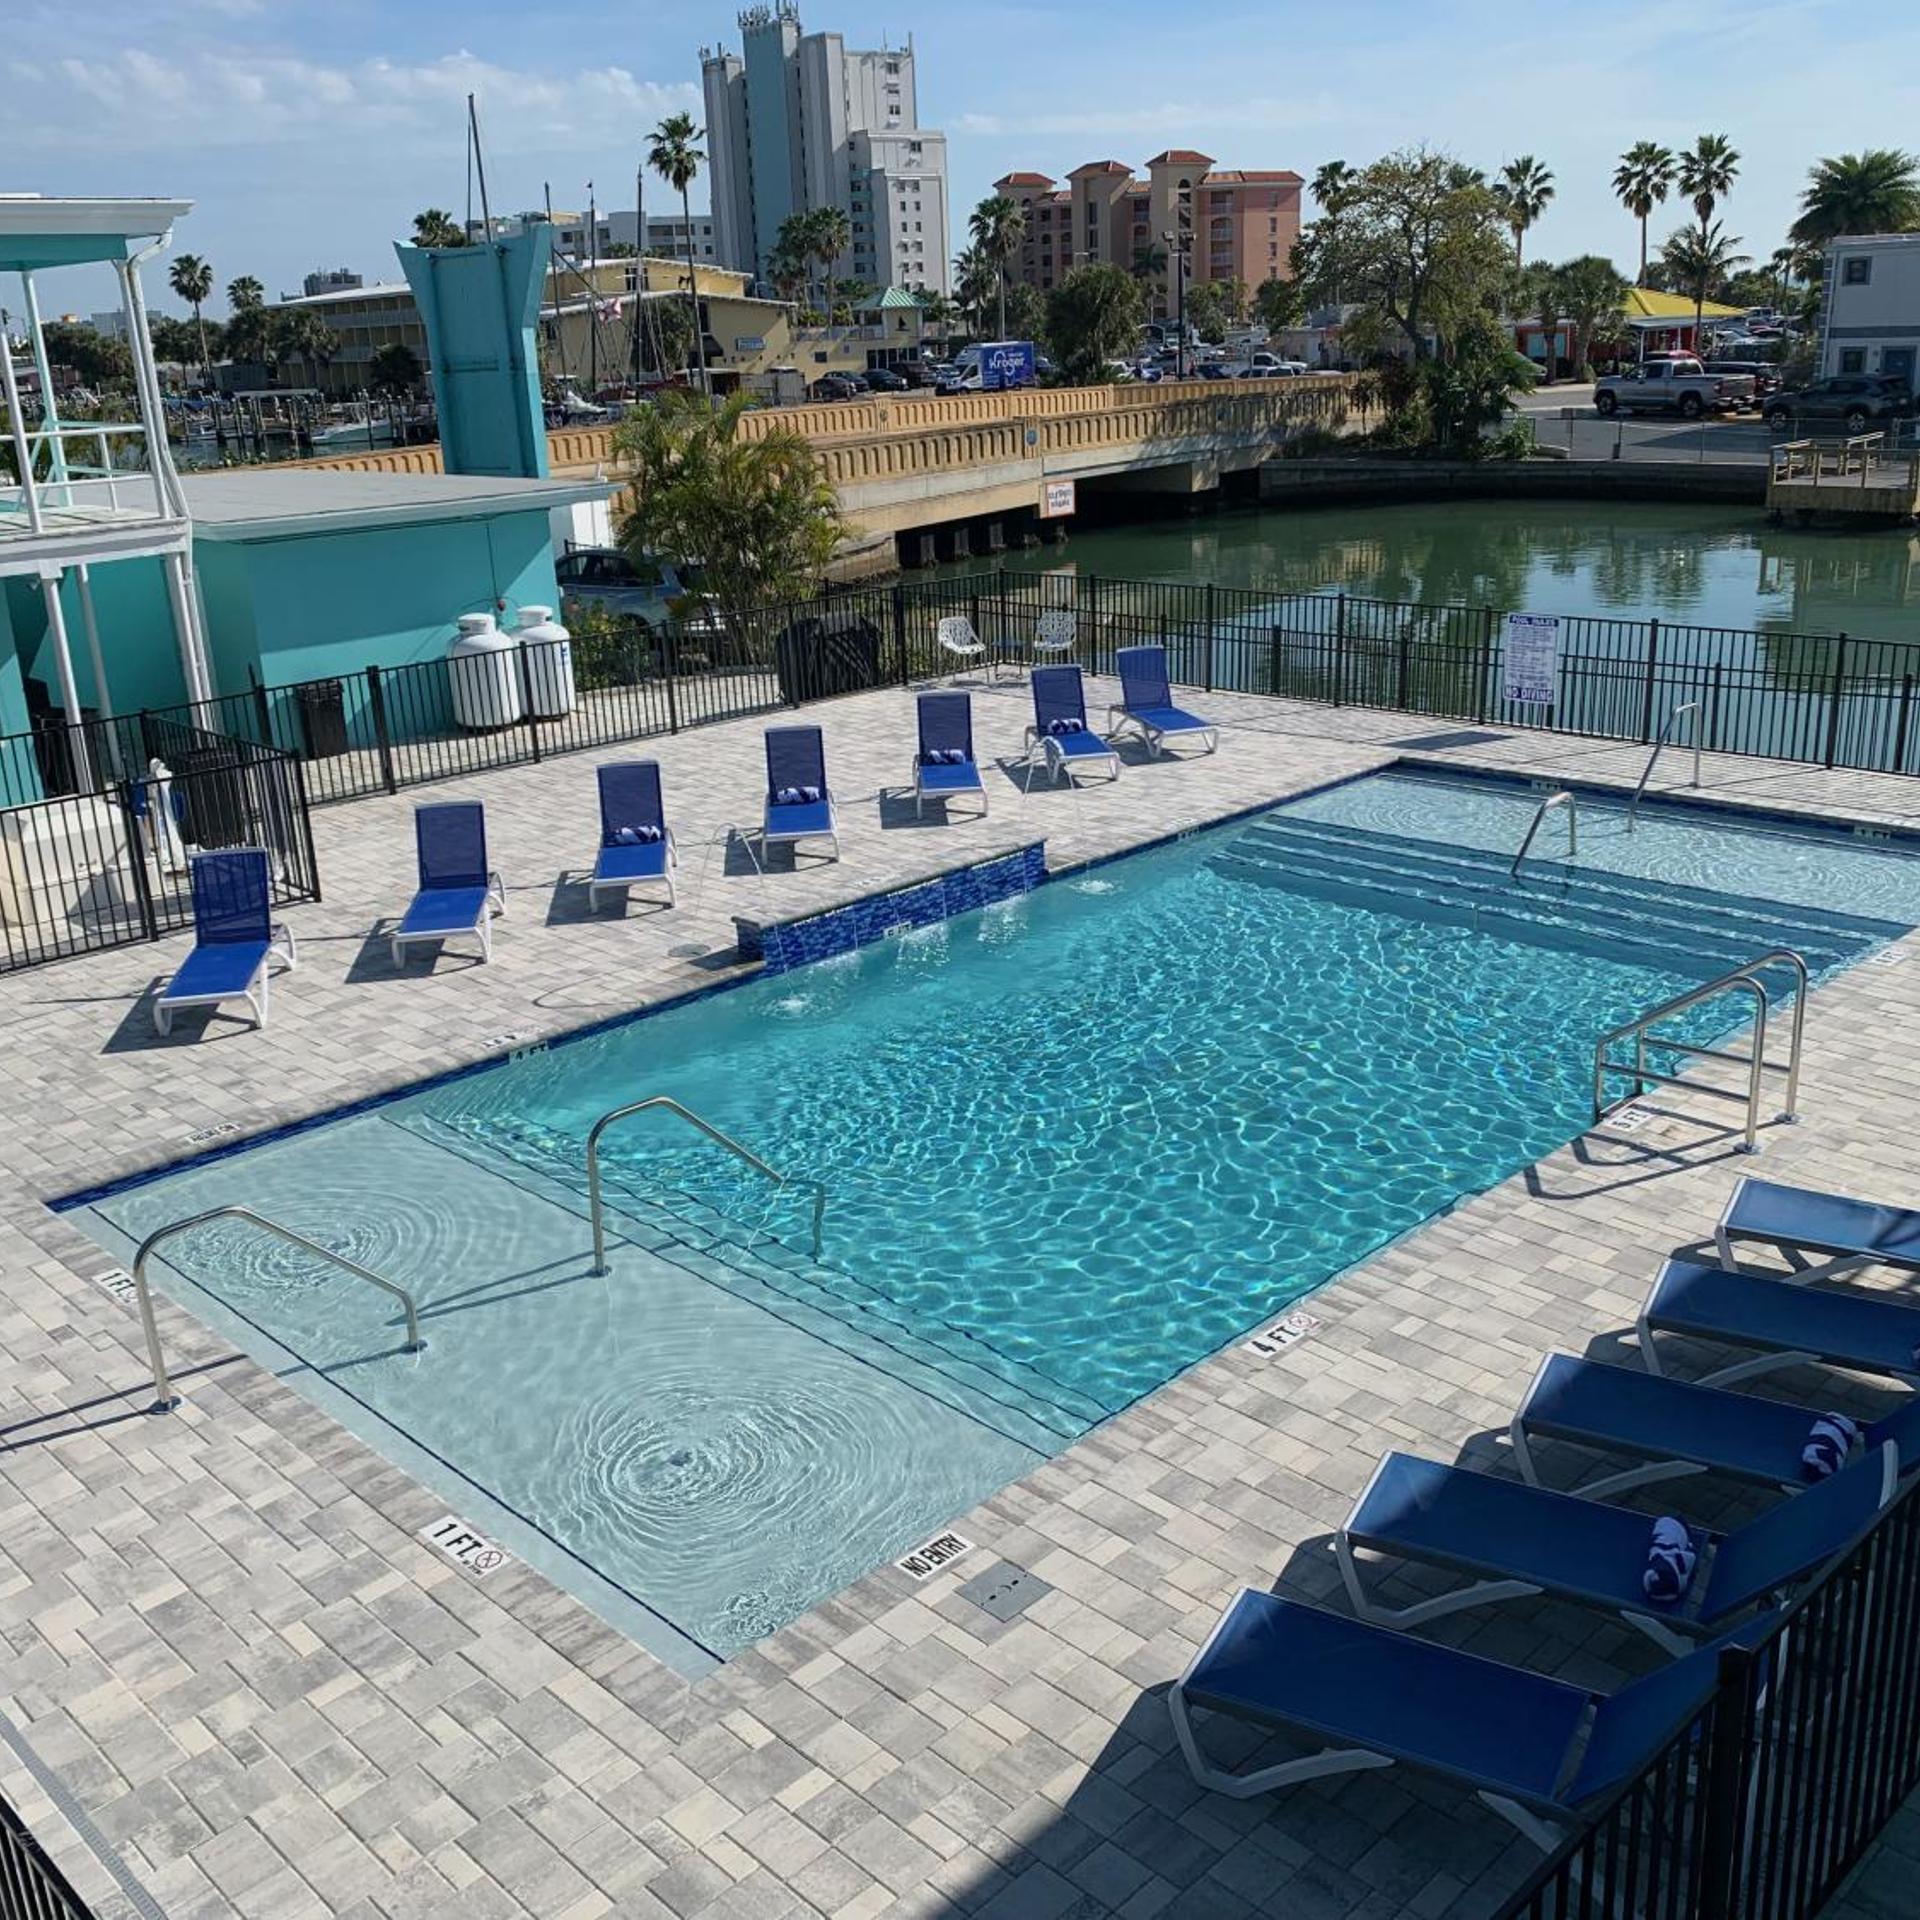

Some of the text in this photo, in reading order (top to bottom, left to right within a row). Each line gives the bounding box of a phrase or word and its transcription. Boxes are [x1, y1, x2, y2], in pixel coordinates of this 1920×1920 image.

[1505, 686, 1553, 701] NO DIVING
[1251, 1325, 1299, 1353] 4 FT
[433, 1523, 458, 1538] 1
[900, 1533, 967, 1577] NO ENTRY
